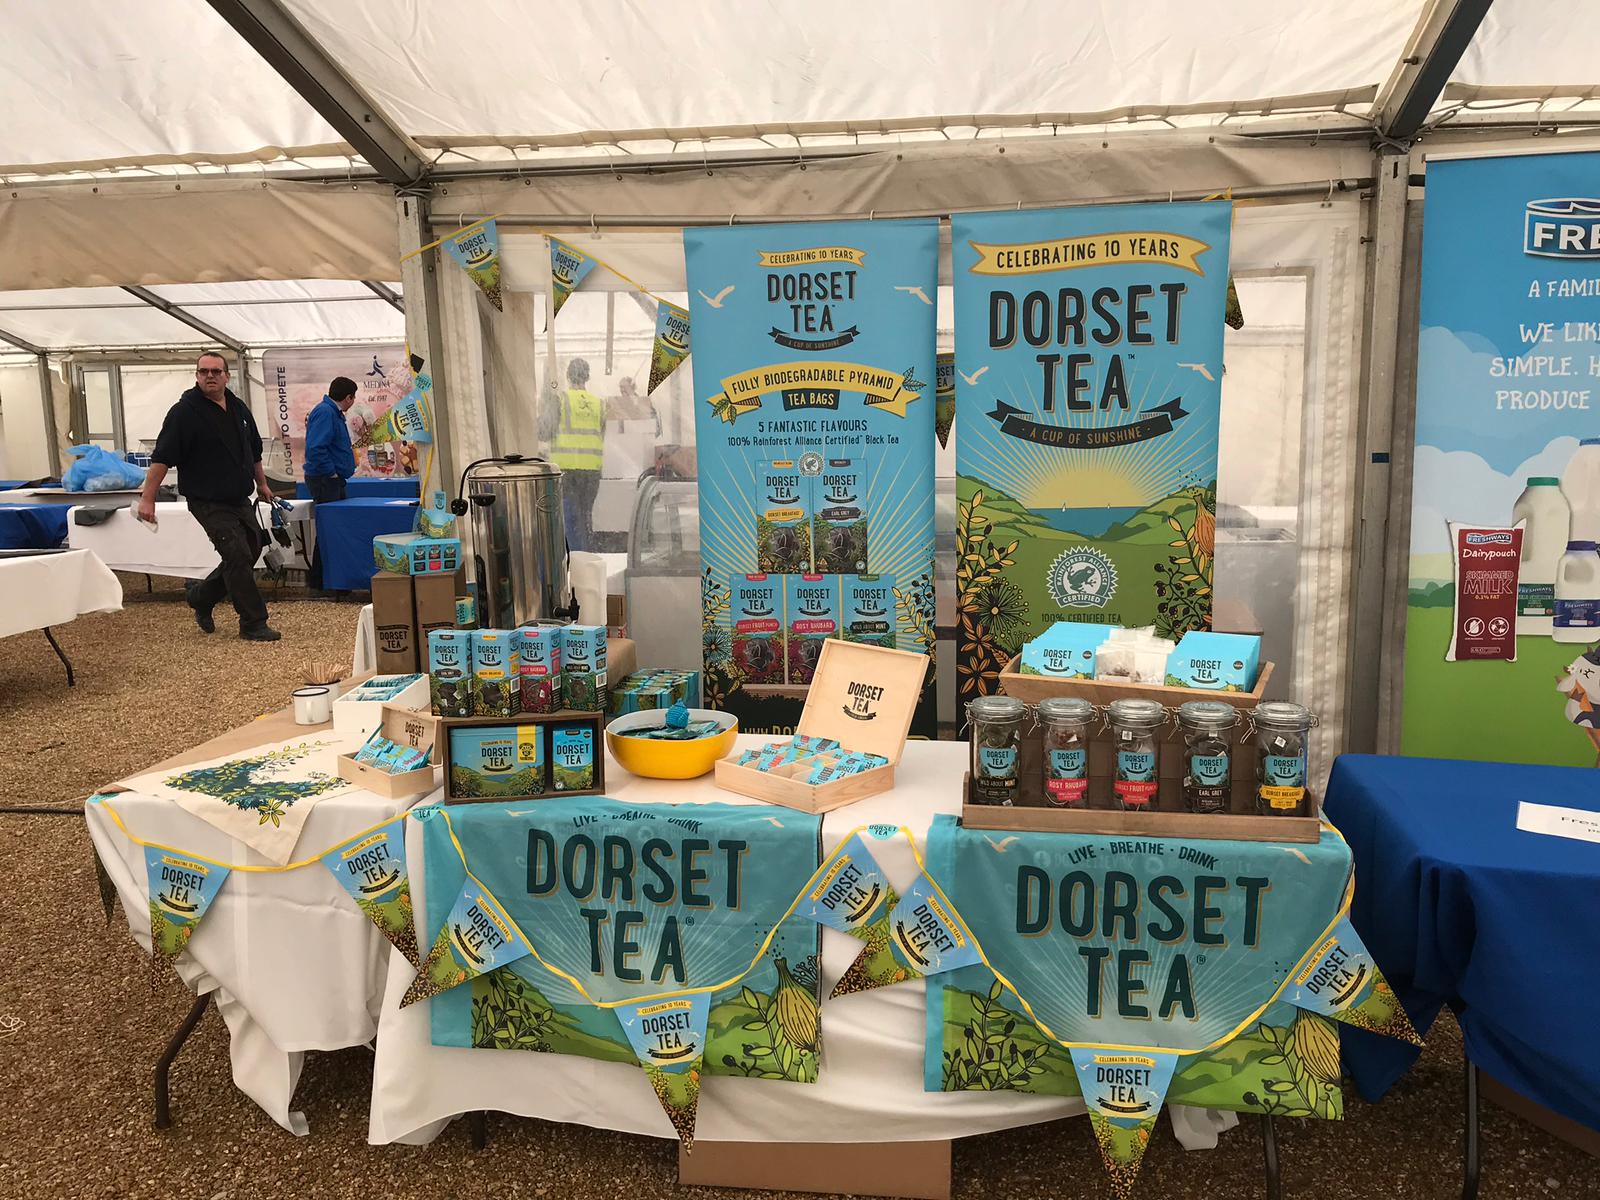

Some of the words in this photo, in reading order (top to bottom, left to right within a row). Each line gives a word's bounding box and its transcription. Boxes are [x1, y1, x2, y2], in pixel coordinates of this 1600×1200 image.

[458, 233, 487, 253] DORSET
[469, 246, 485, 259] TEA
[770, 251, 816, 264] CELEBRATING
[819, 250, 827, 259] 10
[830, 250, 853, 260] YEARS
[997, 243, 1096, 269] CELEBRATING
[1104, 240, 1120, 257] 10
[1129, 238, 1180, 259] YEARS
[556, 252, 580, 271] DORSET
[558, 265, 569, 278] TEA
[767, 270, 857, 302] DORSET
[1528, 279, 1541, 298] A
[790, 304, 834, 333] TEA
[989, 282, 1188, 350] DORSET
[669, 329, 683, 343] TEA
[1519, 322, 1554, 343] WE
[1563, 322, 1600, 342] LIK
[1489, 356, 1579, 377] SIMPLE.
[363, 380, 391, 389] MEDINA
[731, 374, 761, 394] FULLY
[764, 369, 845, 386] BIODEGRADABLE
[849, 371, 894, 390] PYRAMID
[277, 366, 288, 420] COMPETE
[788, 393, 807, 405] TEA
[809, 393, 834, 405] BAGS
[1496, 390, 1591, 410] PRODUCE
[399, 413, 410, 428] TEA
[406, 403, 424, 431] DORSET
[281, 424, 290, 439] TO
[758, 422, 764, 432] 5
[768, 421, 817, 432] FANTASTIC
[820, 420, 868, 432] FLAVOURS
[727, 436, 750, 446] 100%
[753, 435, 792, 446] Rainforest
[794, 435, 822, 445] Alliance
[866, 434, 885, 445] Black
[887, 435, 899, 445] Tea
[1030, 427, 1037, 438] A
[1042, 428, 1063, 443] CUP
[1068, 432, 1081, 445] OF
[1087, 427, 1142, 445] SUNSHINE
[766, 476, 799, 486] DORSET
[823, 475, 856, 486] DORSET
[775, 488, 791, 498] TEA
[832, 487, 848, 497] TEA
[1467, 534, 1510, 543] FRESHWAYS
[1463, 549, 1517, 560] Dairypouch
[1057, 556, 1087, 586] RAINFOREST
[1088, 557, 1108, 586] ALLIANCE
[1465, 571, 1514, 579] SKIMMED
[1464, 579, 1513, 594] MILK
[740, 589, 773, 599] DORSET
[797, 589, 830, 599] DORSET
[854, 589, 886, 599] DORSET
[1062, 594, 1101, 604] CERTIFIED
[749, 600, 765, 610] TEA
[805, 600, 822, 610] TEA
[862, 600, 878, 610] TEA
[1041, 613, 1065, 623] 100%
[1108, 613, 1122, 624] TEA
[380, 631, 408, 640] DORSET
[387, 640, 401, 649] TEA
[435, 646, 458, 654] DORSET
[478, 645, 501, 654] DORSET
[520, 641, 544, 650] DORSET
[567, 640, 588, 648] DORSET
[441, 654, 453, 662] TEA
[484, 654, 495, 662] TEA
[527, 649, 538, 658] TEA
[573, 648, 583, 656] TEA
[1043, 649, 1072, 659] DORSET
[1049, 658, 1063, 667] TEA
[1190, 659, 1222, 670] DORSET
[1197, 669, 1212, 679] TEA
[847, 682, 884, 701] DORSET
[852, 697, 870, 713] TEA
[405, 722, 425, 738] DORSET
[409, 734, 418, 747] TEA
[481, 747, 513, 757] DORSET
[556, 744, 590, 755] DORSET
[986, 751, 1009, 759] DORSET
[489, 757, 505, 767] TEA
[565, 755, 582, 765] TEA
[1057, 752, 1080, 760] DORSET
[1125, 754, 1148, 763] DORSET
[1199, 758, 1223, 767] DORSET
[1273, 759, 1297, 767] DORSET
[1279, 767, 1292, 775] TEA
[419, 810, 431, 819] TEA
[869, 824, 897, 832] DORSET
[347, 843, 389, 875] DORSET
[1068, 844, 1097, 865] LIVE
[1109, 842, 1164, 857] BREATHE
[1178, 846, 1219, 871] DRINK
[363, 864, 388, 884] TEA
[526, 827, 751, 910] DORSET
[162, 866, 204, 891] DORSET
[821, 863, 862, 910] DORSET
[170, 884, 189, 904] TEA
[842, 886, 869, 911] TEA
[1016, 864, 1273, 949] DORSET
[467, 905, 504, 950] DORSET
[913, 904, 955, 953] DORSET
[464, 924, 484, 952] TEA
[907, 923, 931, 953] TEA
[1306, 945, 1349, 995] DORSET
[1327, 968, 1354, 993] TEA
[642, 1012, 690, 1035] DORSET
[657, 1032, 682, 1050] TEA
[1097, 1066, 1151, 1086] DORSET
[1110, 1085, 1136, 1104] TEA
